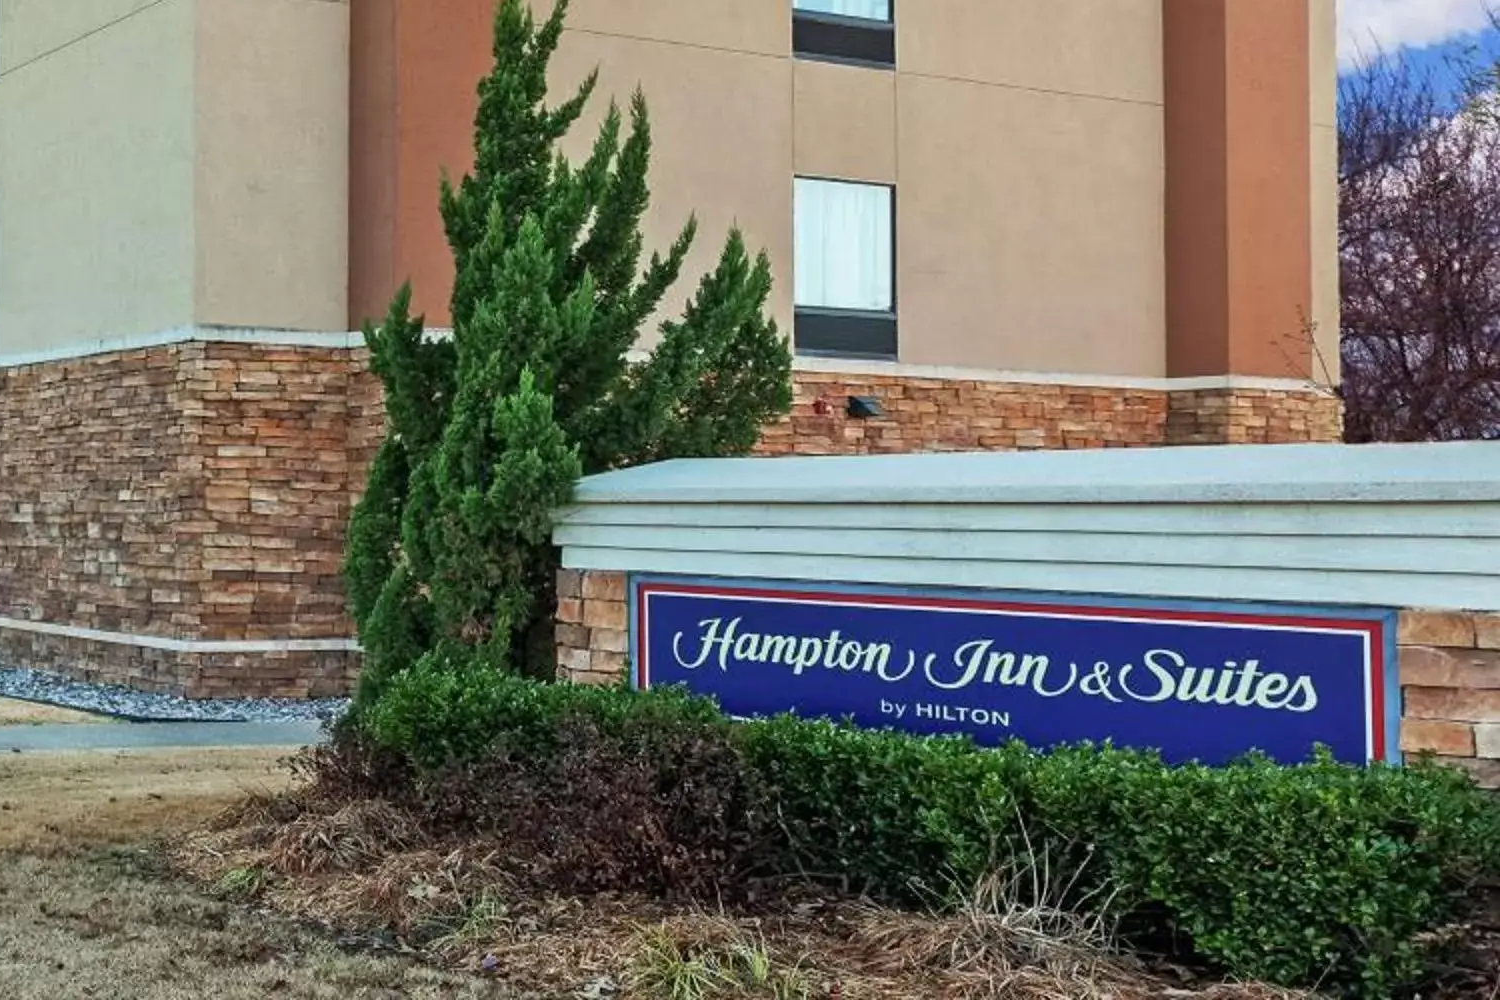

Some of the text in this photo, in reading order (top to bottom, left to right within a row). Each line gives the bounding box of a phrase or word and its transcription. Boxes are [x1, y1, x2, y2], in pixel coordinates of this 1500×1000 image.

[672, 615, 1318, 713] Hampton Inn & Suites
[880, 698, 1011, 727] by HILTON
